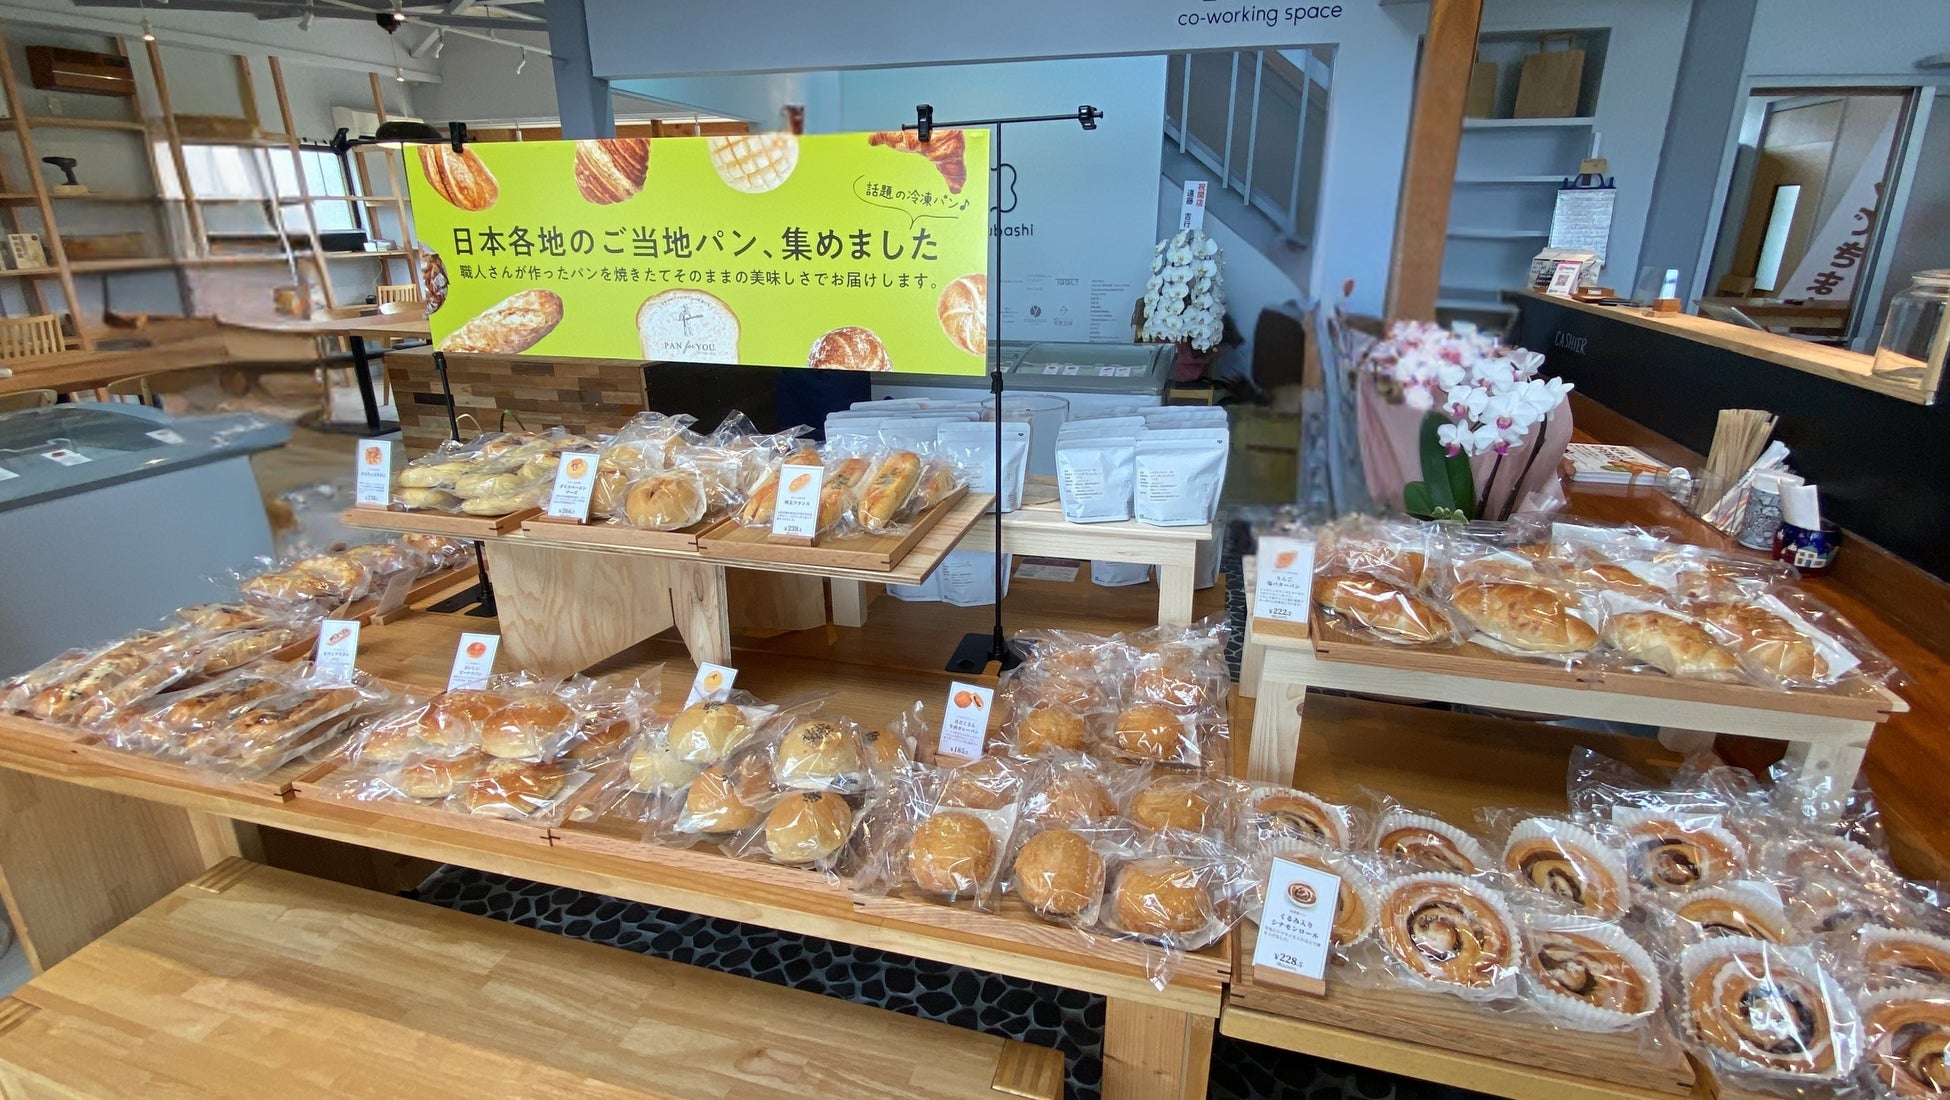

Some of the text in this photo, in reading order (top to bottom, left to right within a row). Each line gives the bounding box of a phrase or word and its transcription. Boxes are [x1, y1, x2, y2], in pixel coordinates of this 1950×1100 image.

[1178, 5, 1343, 27] co-working space
[453, 226, 938, 261] 日本各地のご当地パン、集めました
[459, 264, 937, 289] 職人さんが作ったパンを焼きたてそのままの美味しさでお届けします。
[664, 341, 682, 350] PAN
[696, 342, 715, 351] YOU
[1554, 330, 1588, 356] CASHIER
[1271, 919, 1319, 939] シナモンロール
[1280, 913, 1313, 928] くるみ入り
